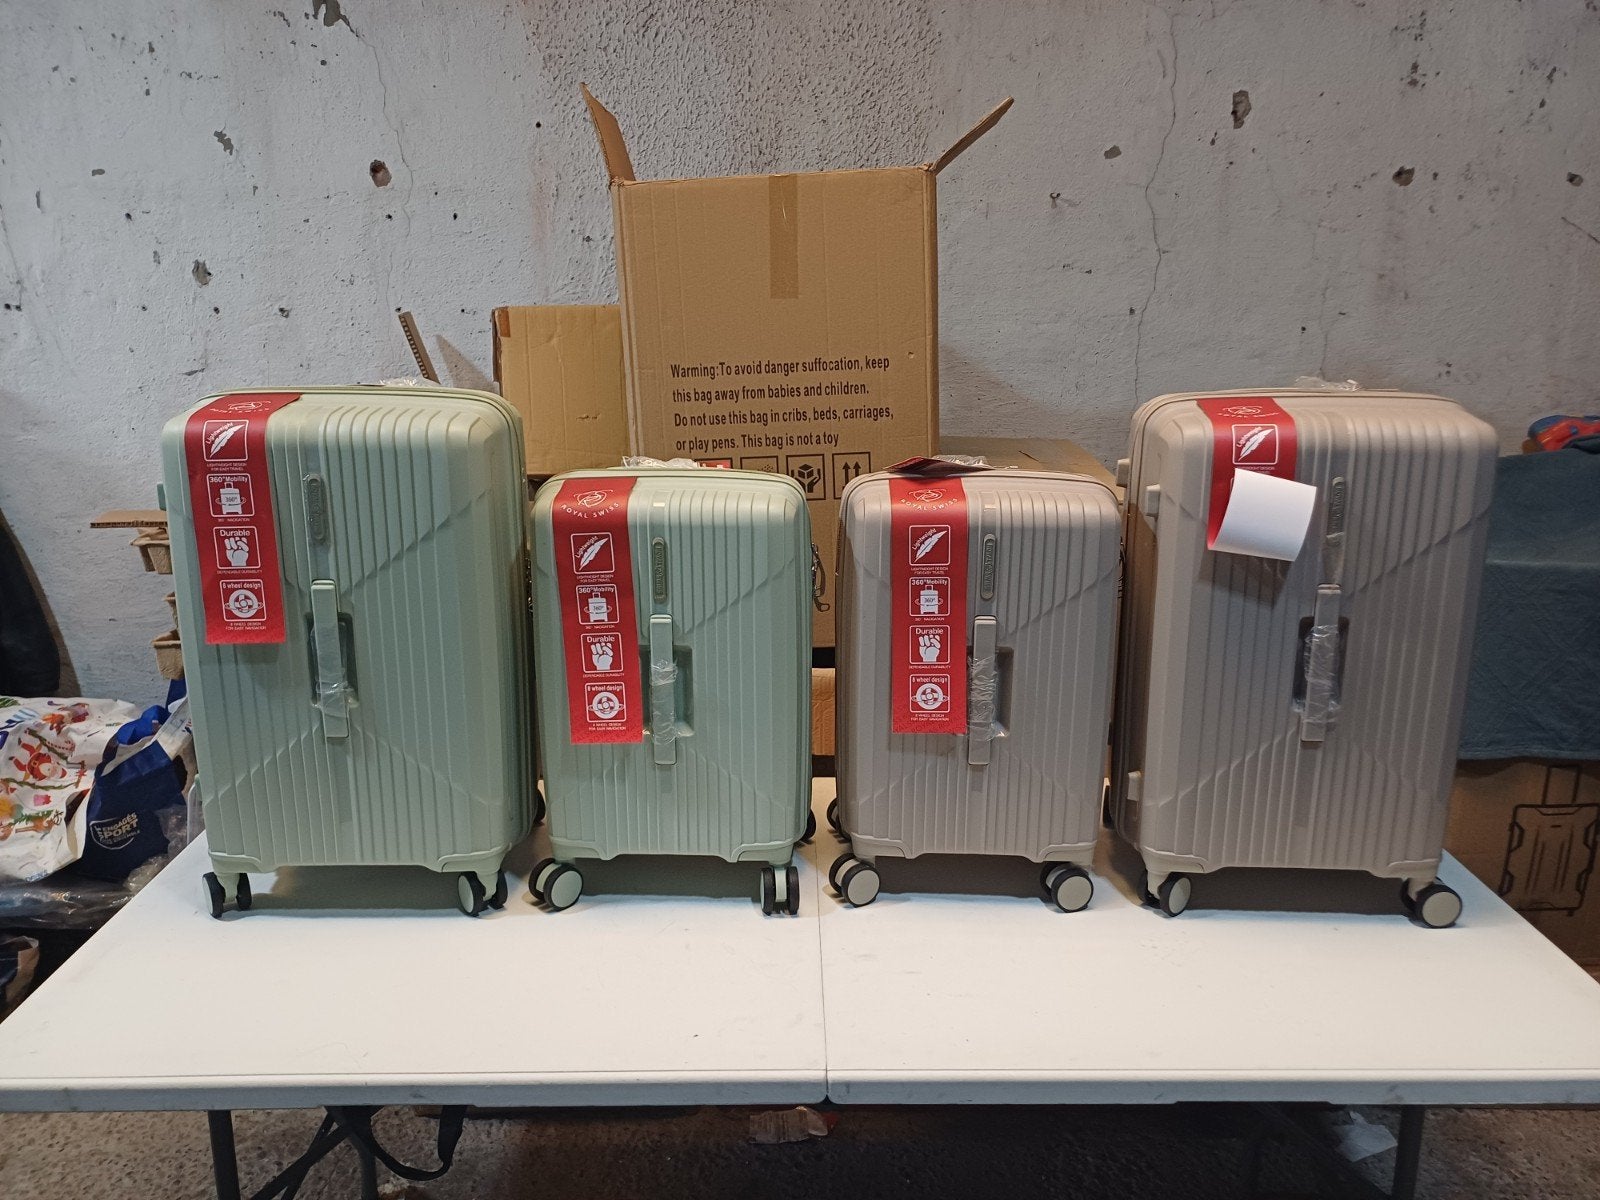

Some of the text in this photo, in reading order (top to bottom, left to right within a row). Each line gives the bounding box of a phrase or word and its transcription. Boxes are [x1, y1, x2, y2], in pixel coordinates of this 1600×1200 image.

[734, 360, 762, 375] avoid
[764, 359, 800, 377] danger
[802, 357, 863, 372] suffocation,
[865, 355, 890, 371] keep
[672, 381, 869, 405] this bag away from babies and children.
[674, 405, 894, 427] Do not use this bag in cribs, beds, carriages,
[676, 431, 839, 453] or play pens. This bag is not a toy
[561, 502, 619, 518] ROYAL SWISS
[901, 498, 958, 511] ROYAL SWISS
[220, 529, 250, 537] Durable
[243, 582, 261, 590] design
[915, 627, 944, 635] Durable
[586, 635, 615, 643] Durable
[931, 676, 948, 684] design
